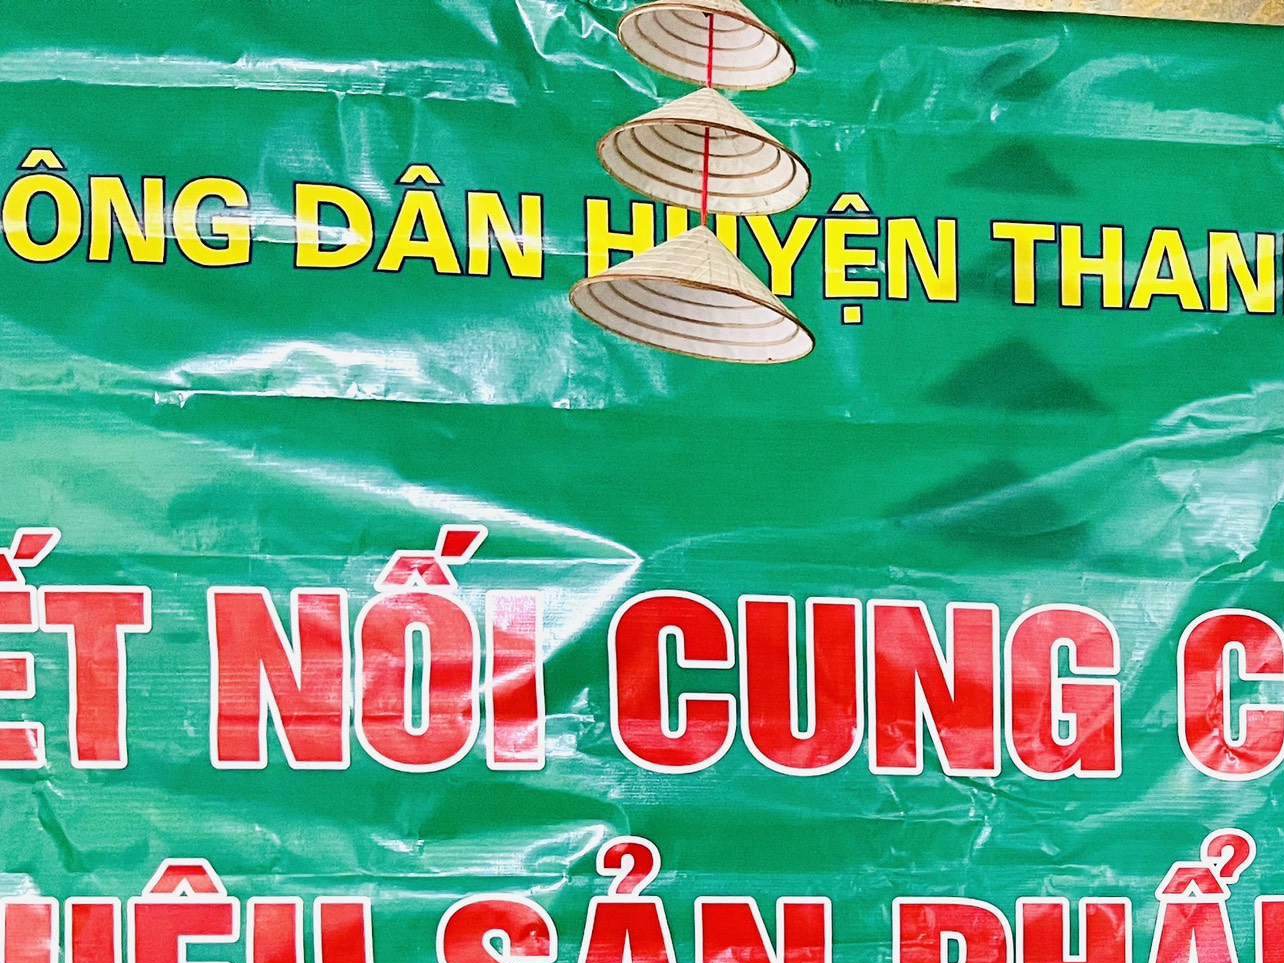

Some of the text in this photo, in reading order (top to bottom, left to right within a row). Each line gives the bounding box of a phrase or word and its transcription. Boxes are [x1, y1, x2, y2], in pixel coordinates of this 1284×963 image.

[0, 147, 252, 268] ÔNG
[294, 164, 544, 280] DÂN
[207, 523, 546, 773] NỐI
[607, 589, 1123, 780] CUNG
